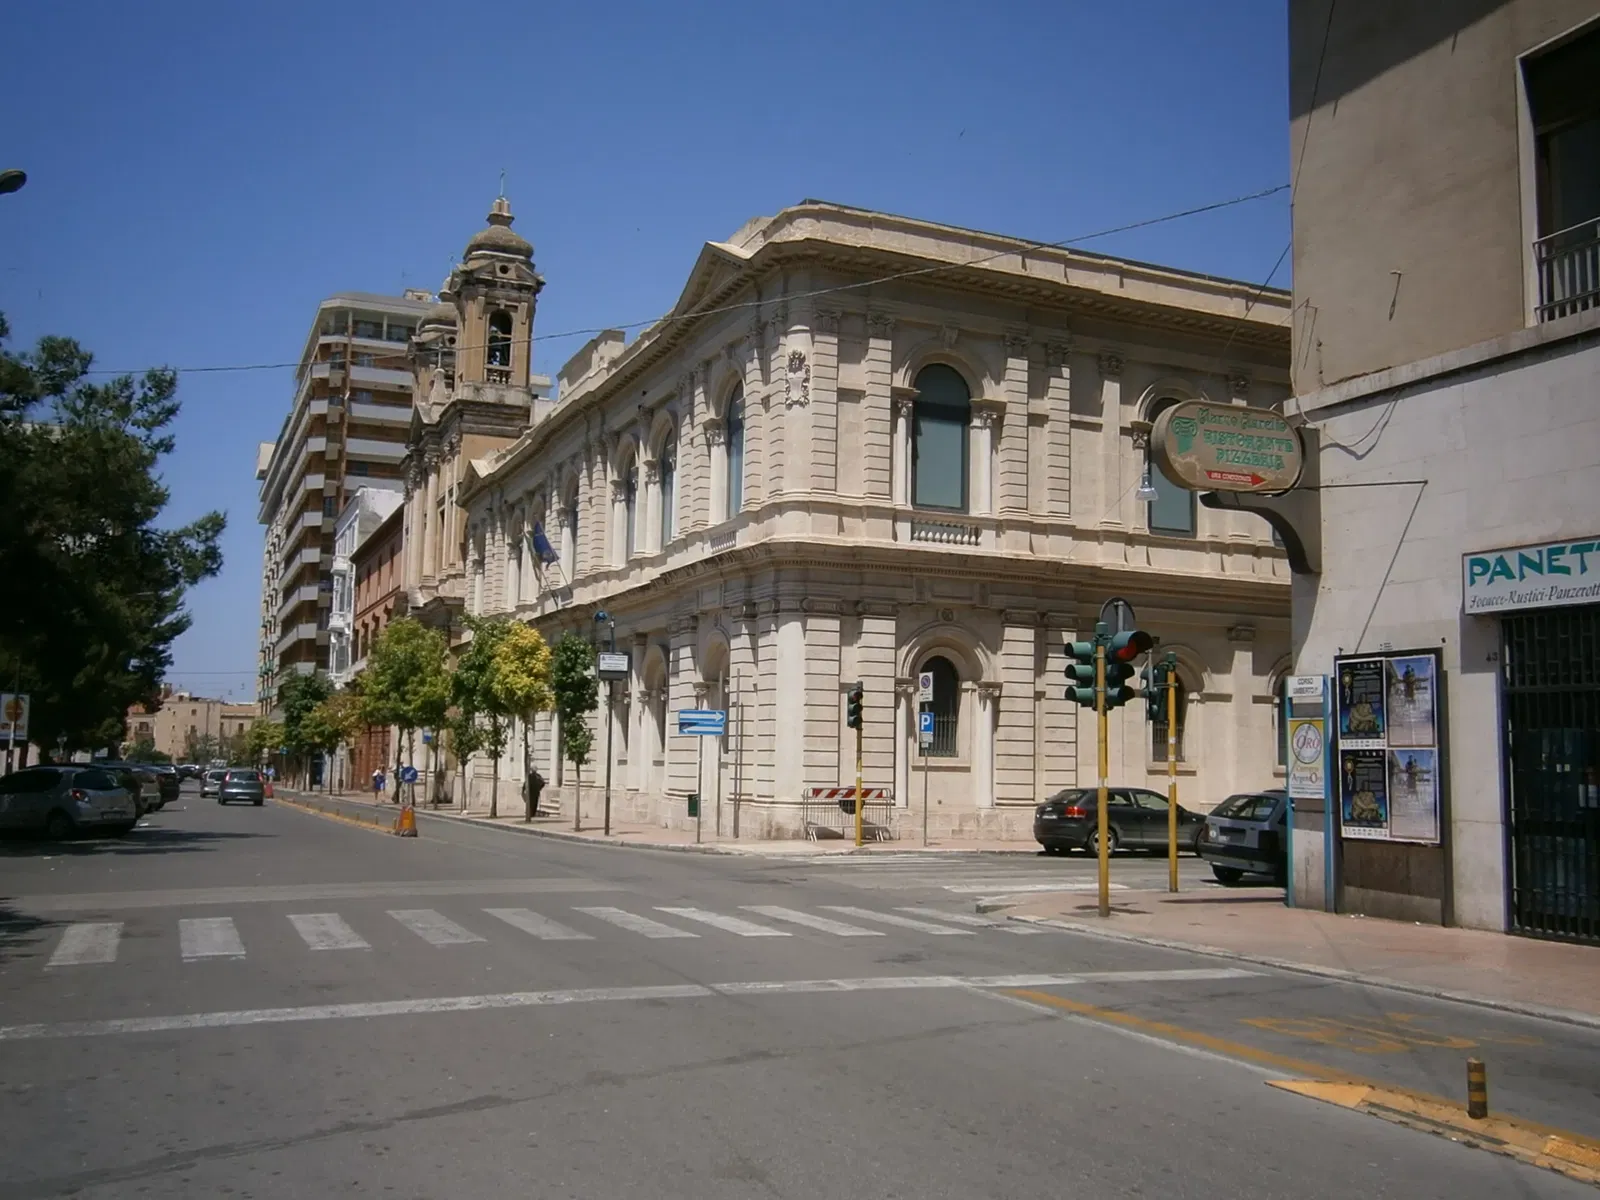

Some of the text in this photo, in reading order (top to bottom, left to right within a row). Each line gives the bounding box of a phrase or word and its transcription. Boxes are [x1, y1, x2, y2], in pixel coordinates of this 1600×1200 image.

[1216, 448, 1285, 471] PIZZERIA
[1468, 541, 1600, 588] PANET
[920, 714, 931, 730] P
